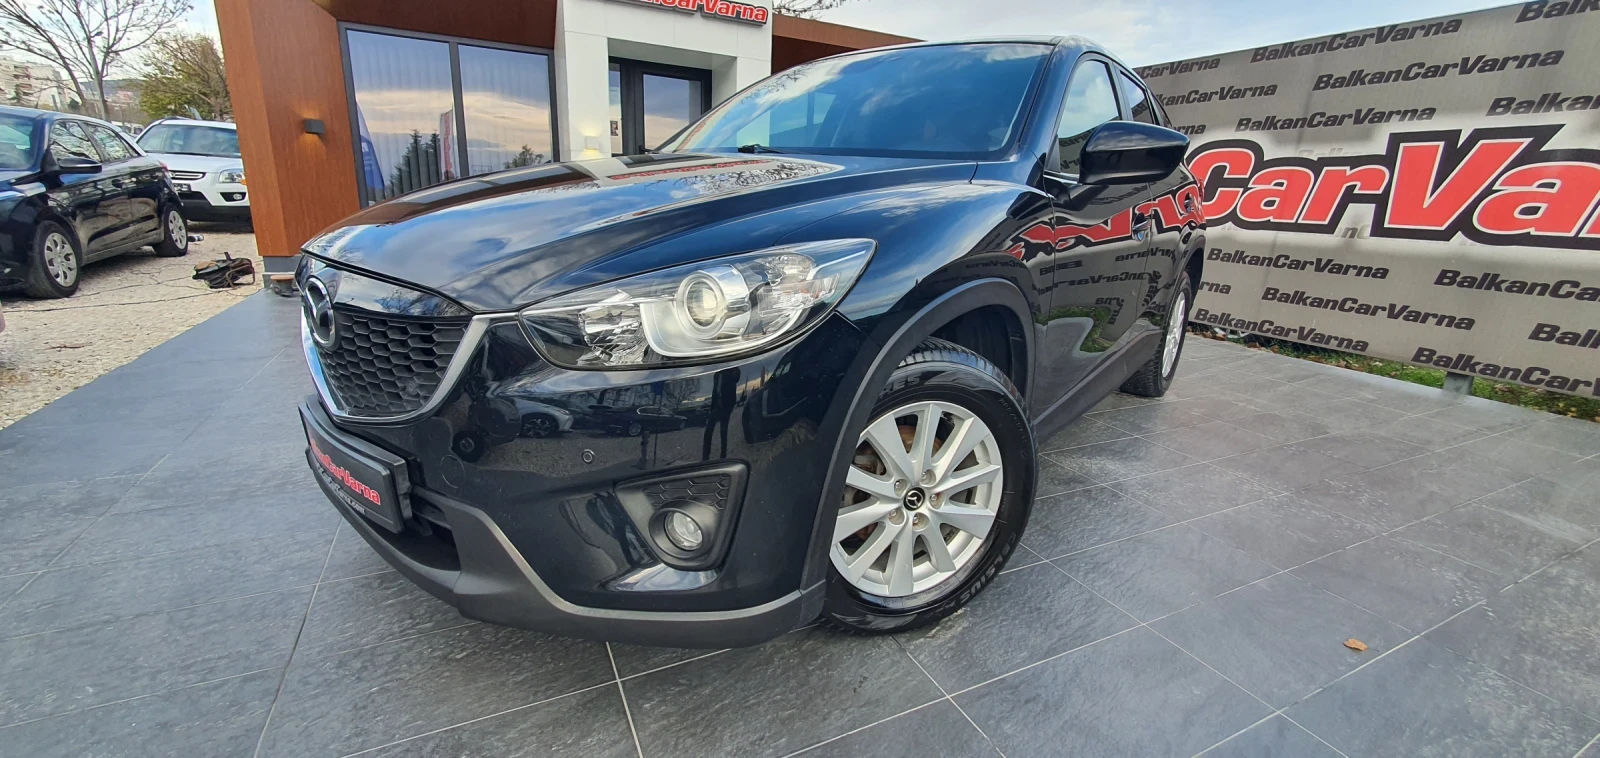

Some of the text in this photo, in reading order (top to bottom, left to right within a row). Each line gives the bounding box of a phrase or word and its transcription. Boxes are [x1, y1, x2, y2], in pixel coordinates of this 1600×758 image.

[1251, 19, 1463, 64] BalkanCarVarna
[1312, 50, 1564, 91] BalkanCarVarna
[1235, 106, 1436, 133] BalkanCarVarna
[1207, 248, 1389, 279] BalkanCarVarna
[1261, 287, 1475, 330] BalkanCarVarna
[1194, 308, 1369, 352] BalkanCarVarna
